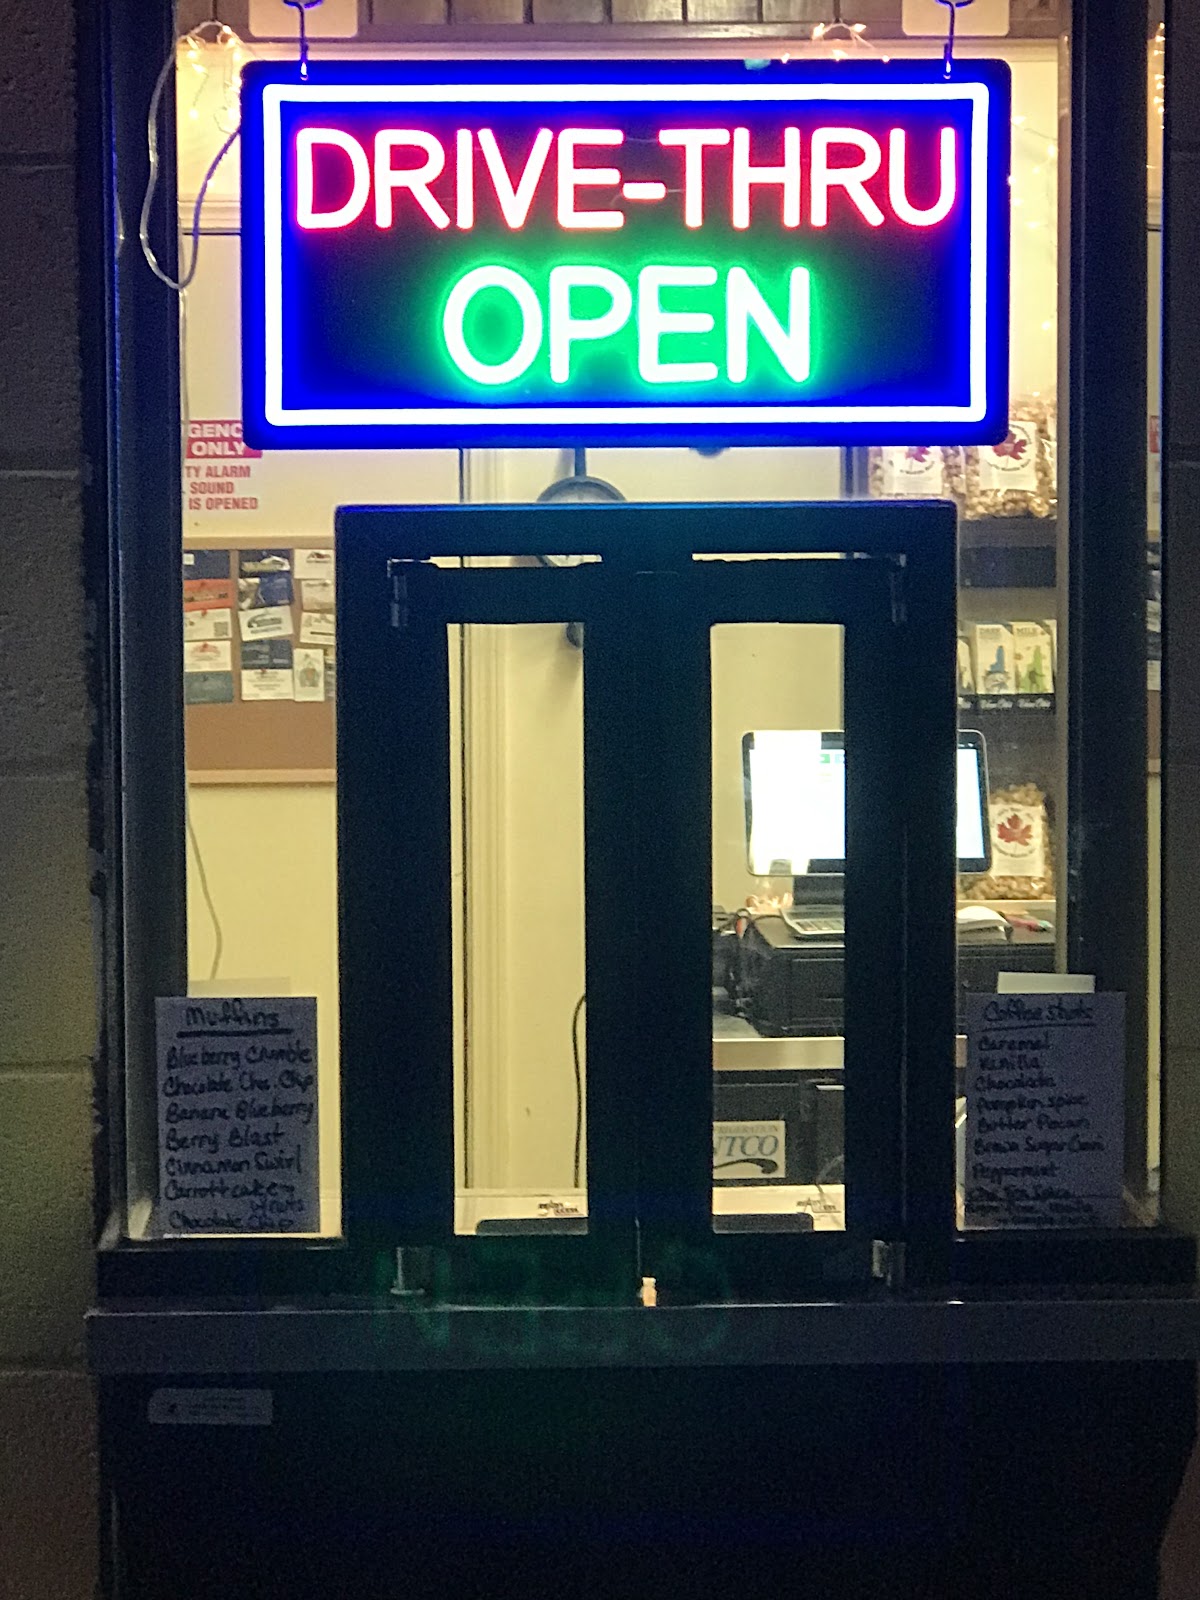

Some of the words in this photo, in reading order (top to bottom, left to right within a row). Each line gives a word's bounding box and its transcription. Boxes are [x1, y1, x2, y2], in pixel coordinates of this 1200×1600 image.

[296, 127, 957, 230] DRIVE-THRU
[443, 265, 811, 384] OPEN
[191, 441, 246, 456] ONLY
[185, 465, 201, 478] TY
[205, 465, 251, 478] ALARM
[190, 481, 234, 494] SOUND
[189, 497, 201, 510] IS
[205, 497, 258, 510] OPENED
[186, 998, 280, 1027] Muffins
[984, 998, 1043, 1022] Coffee
[978, 1031, 1050, 1051] Caramel
[166, 1127, 219, 1154] Berry
[228, 1122, 285, 1147] Blast
[165, 1156, 251, 1176] Cinnamon
[254, 1144, 302, 1174] Swirl
